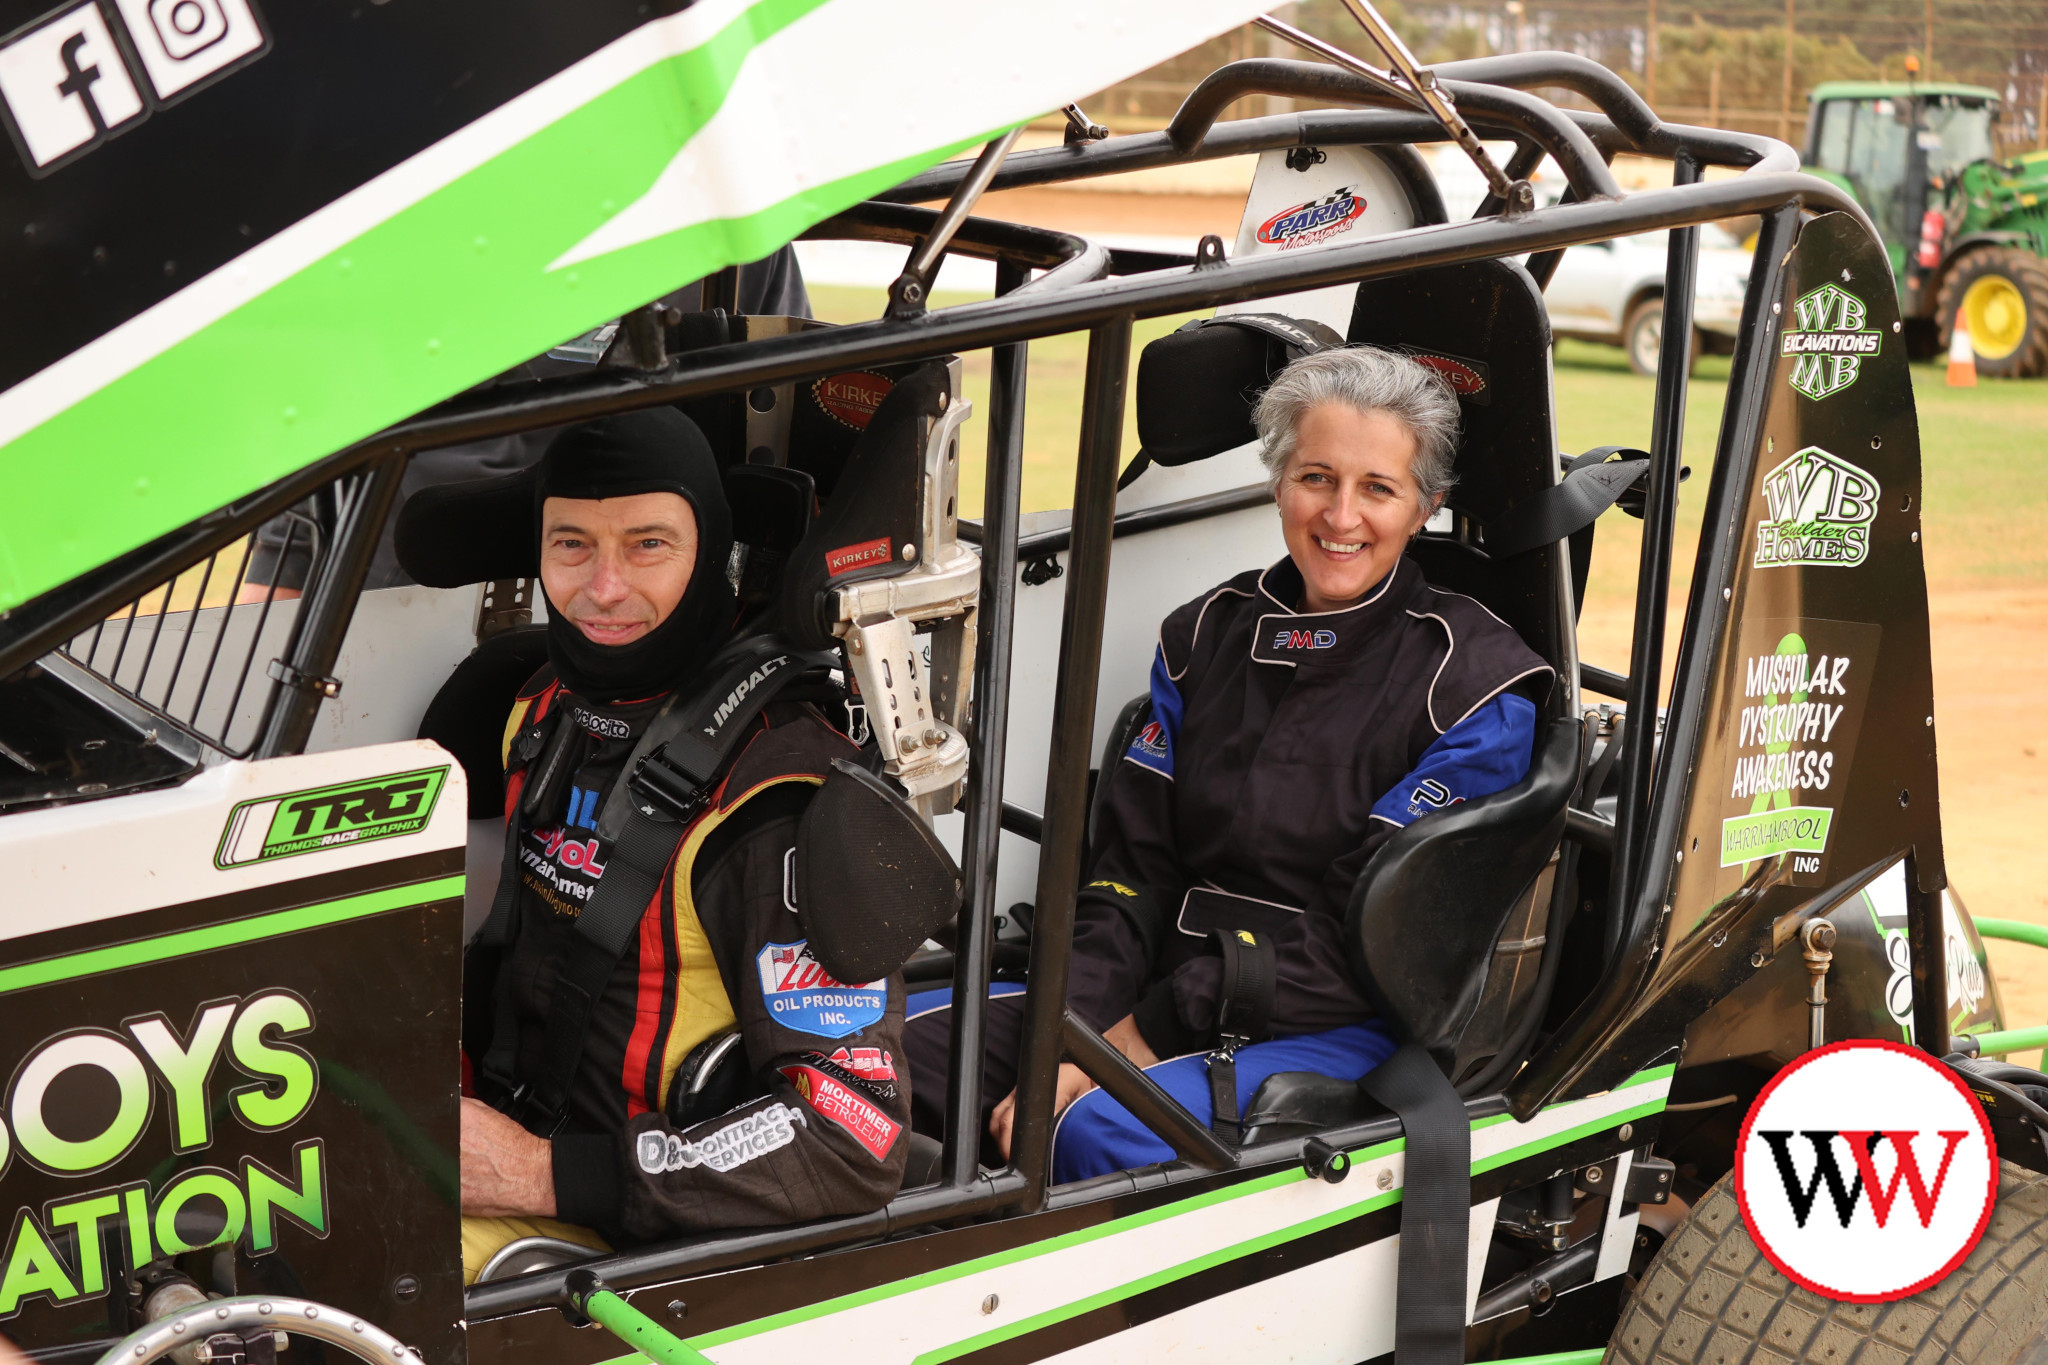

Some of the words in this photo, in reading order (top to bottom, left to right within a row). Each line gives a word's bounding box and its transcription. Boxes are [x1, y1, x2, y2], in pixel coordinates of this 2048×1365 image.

[1269, 197, 1354, 240] PARR
[1795, 286, 1866, 331] WB
[1783, 334, 1879, 353] EXCAVATIONS
[826, 381, 887, 406] KIRKE
[1766, 454, 1877, 521] WB
[1757, 526, 1867, 563] HOMES
[1779, 520, 1845, 538] Builder
[832, 548, 878, 568] KIRKEY
[1273, 629, 1337, 649] PMD
[713, 655, 787, 728] IMPACT
[1745, 653, 1850, 698] MUSCULAR
[1739, 701, 1844, 748] DYSTROPHY
[1731, 749, 1834, 799] AWARENESS
[287, 777, 430, 837] TRG
[1726, 817, 1822, 853] WARRNAMBOOL
[1793, 856, 1820, 873] INC
[773, 999, 800, 1012] OIL
[803, 994, 881, 1009] PRODUCTS
[820, 1012, 851, 1025] INC.
[0, 994, 314, 1173] OYS
[814, 1092, 887, 1151] PETROLEUM
[820, 1079, 892, 1138] MORTIMER
[708, 1122, 790, 1168] ERVICES
